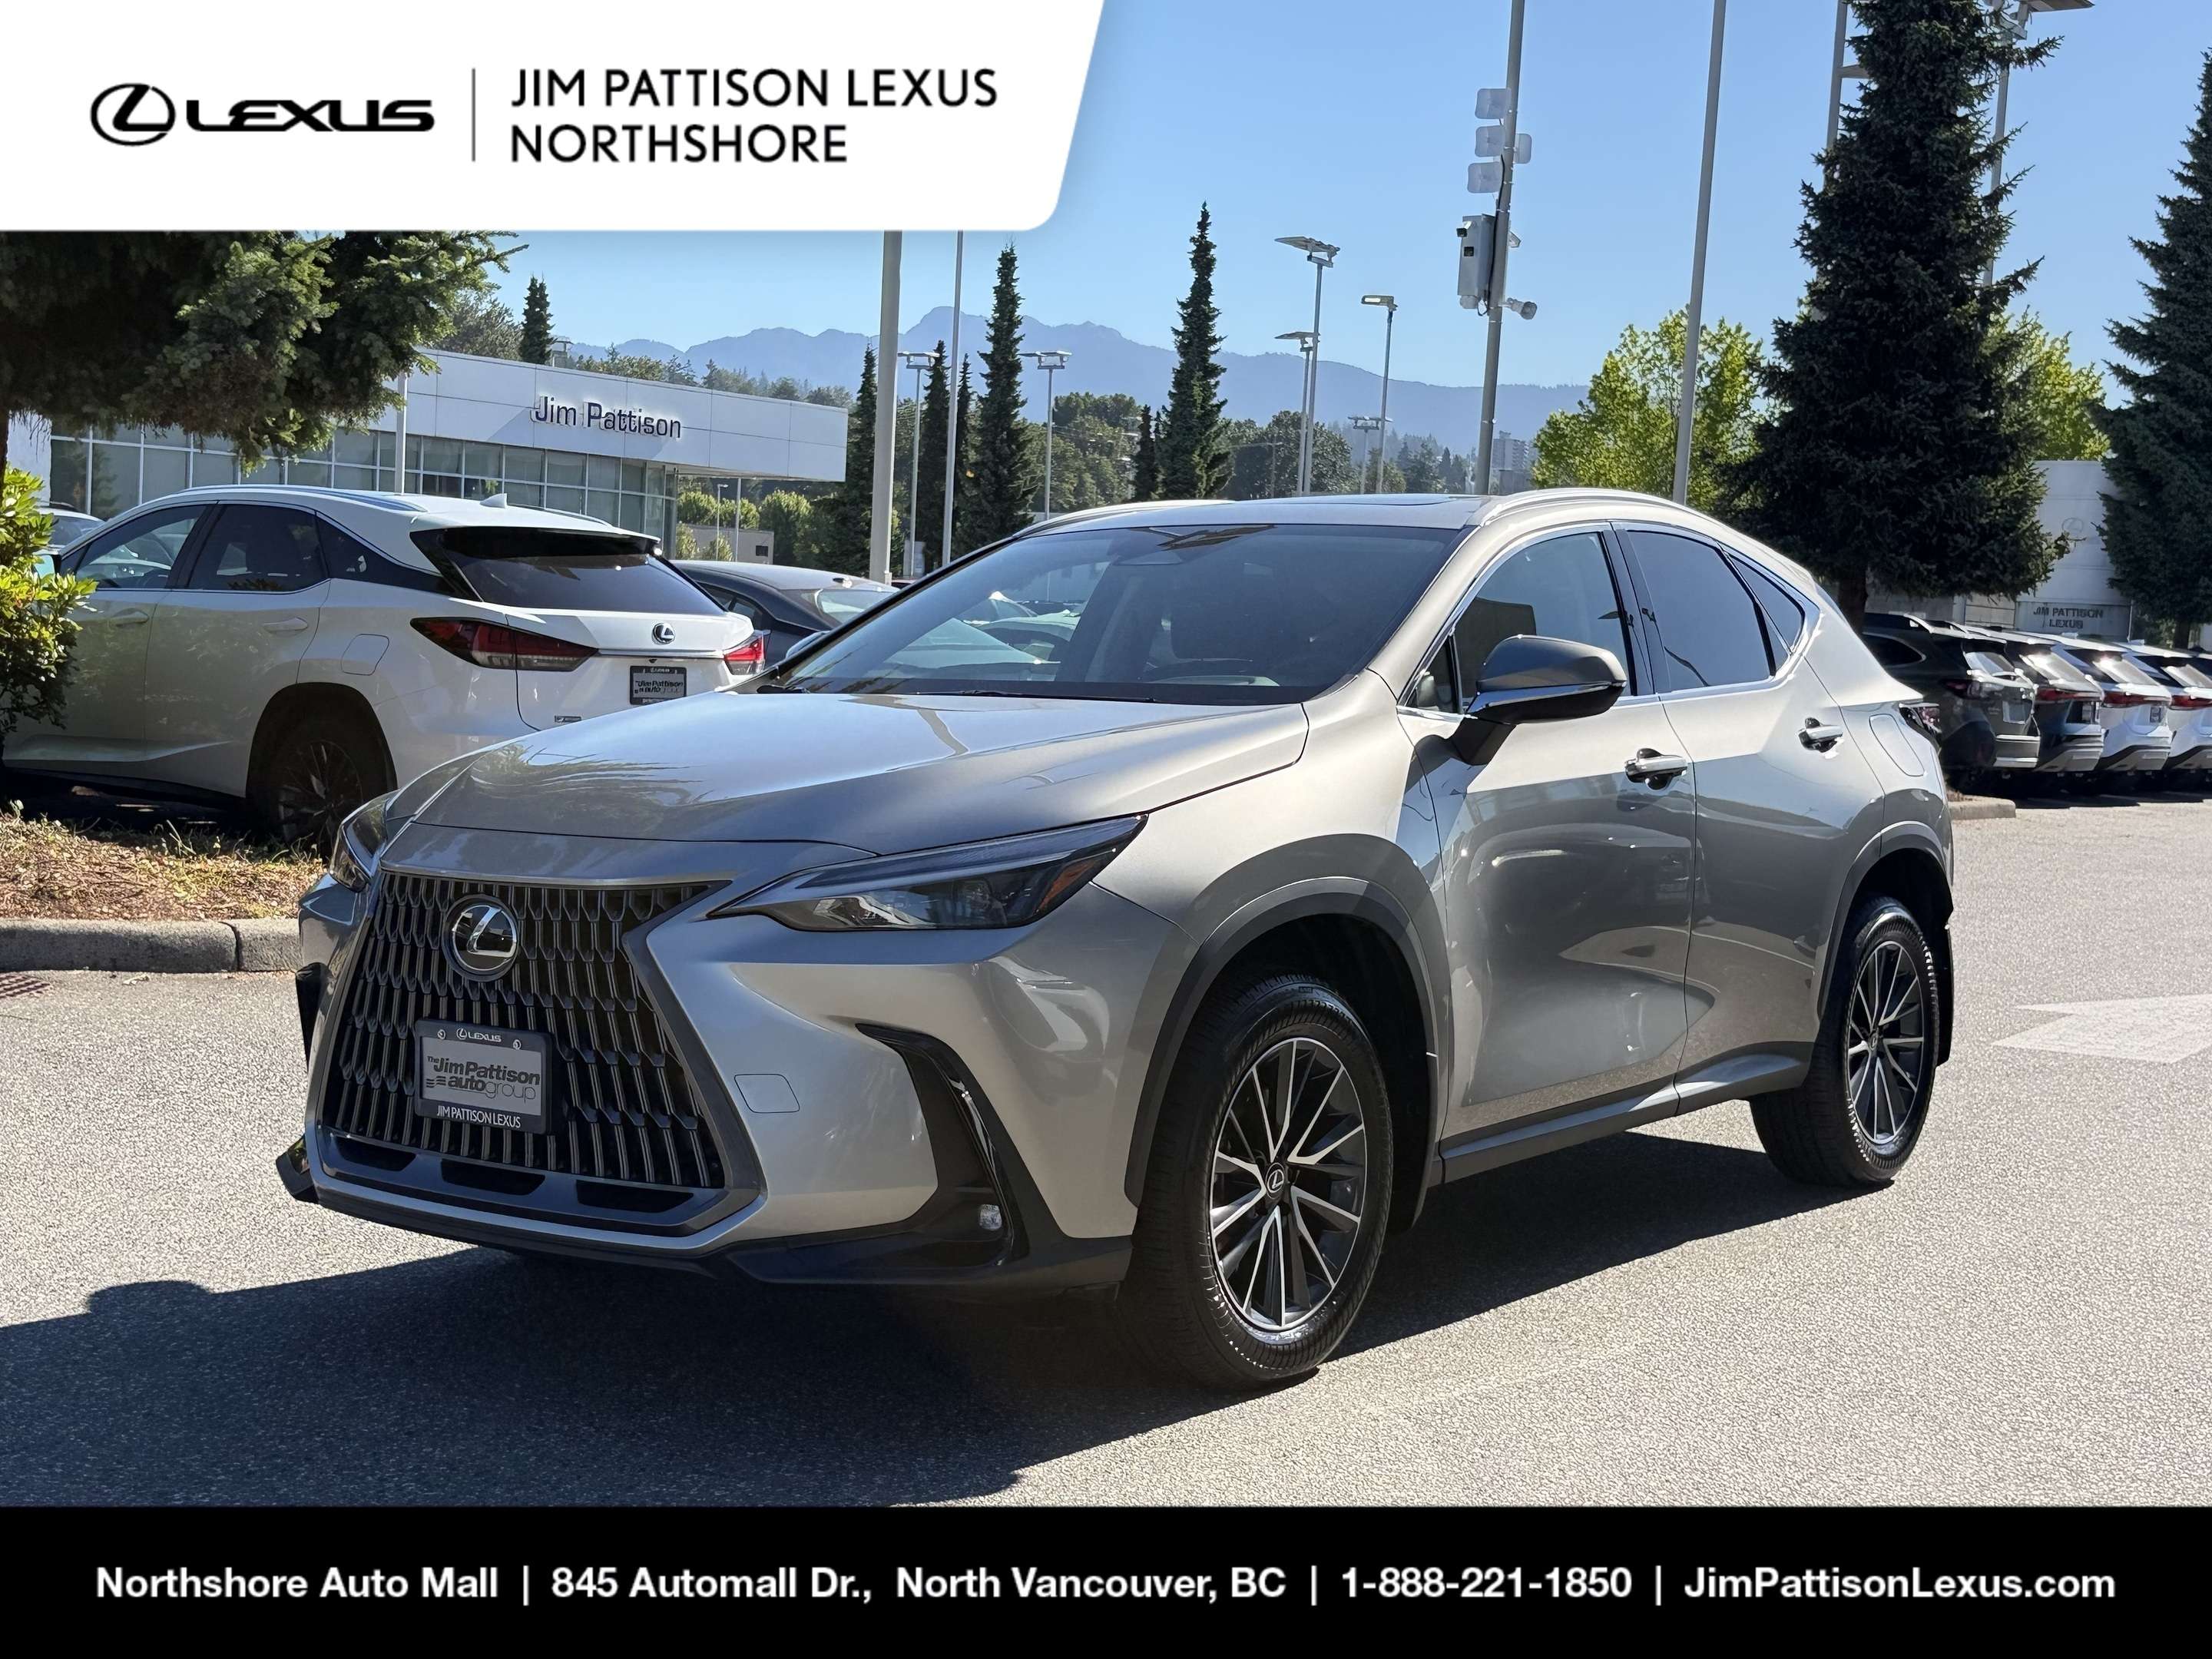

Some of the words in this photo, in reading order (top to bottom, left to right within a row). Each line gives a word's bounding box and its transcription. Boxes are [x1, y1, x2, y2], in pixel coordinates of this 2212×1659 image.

[535, 396, 577, 426] Jim
[585, 402, 681, 439] Pattison
[2033, 607, 2049, 615] JIM
[2052, 608, 2104, 618] PATTISON
[2049, 618, 2084, 629] LEXUS
[467, 1031, 502, 1043] LEXUS
[426, 1055, 439, 1065] The
[433, 1057, 464, 1075] Jim
[465, 1061, 541, 1086] Pattison
[436, 1104, 450, 1118] JIM
[451, 1106, 492, 1124] PATTISON
[492, 1114, 522, 1128] LEXUS
